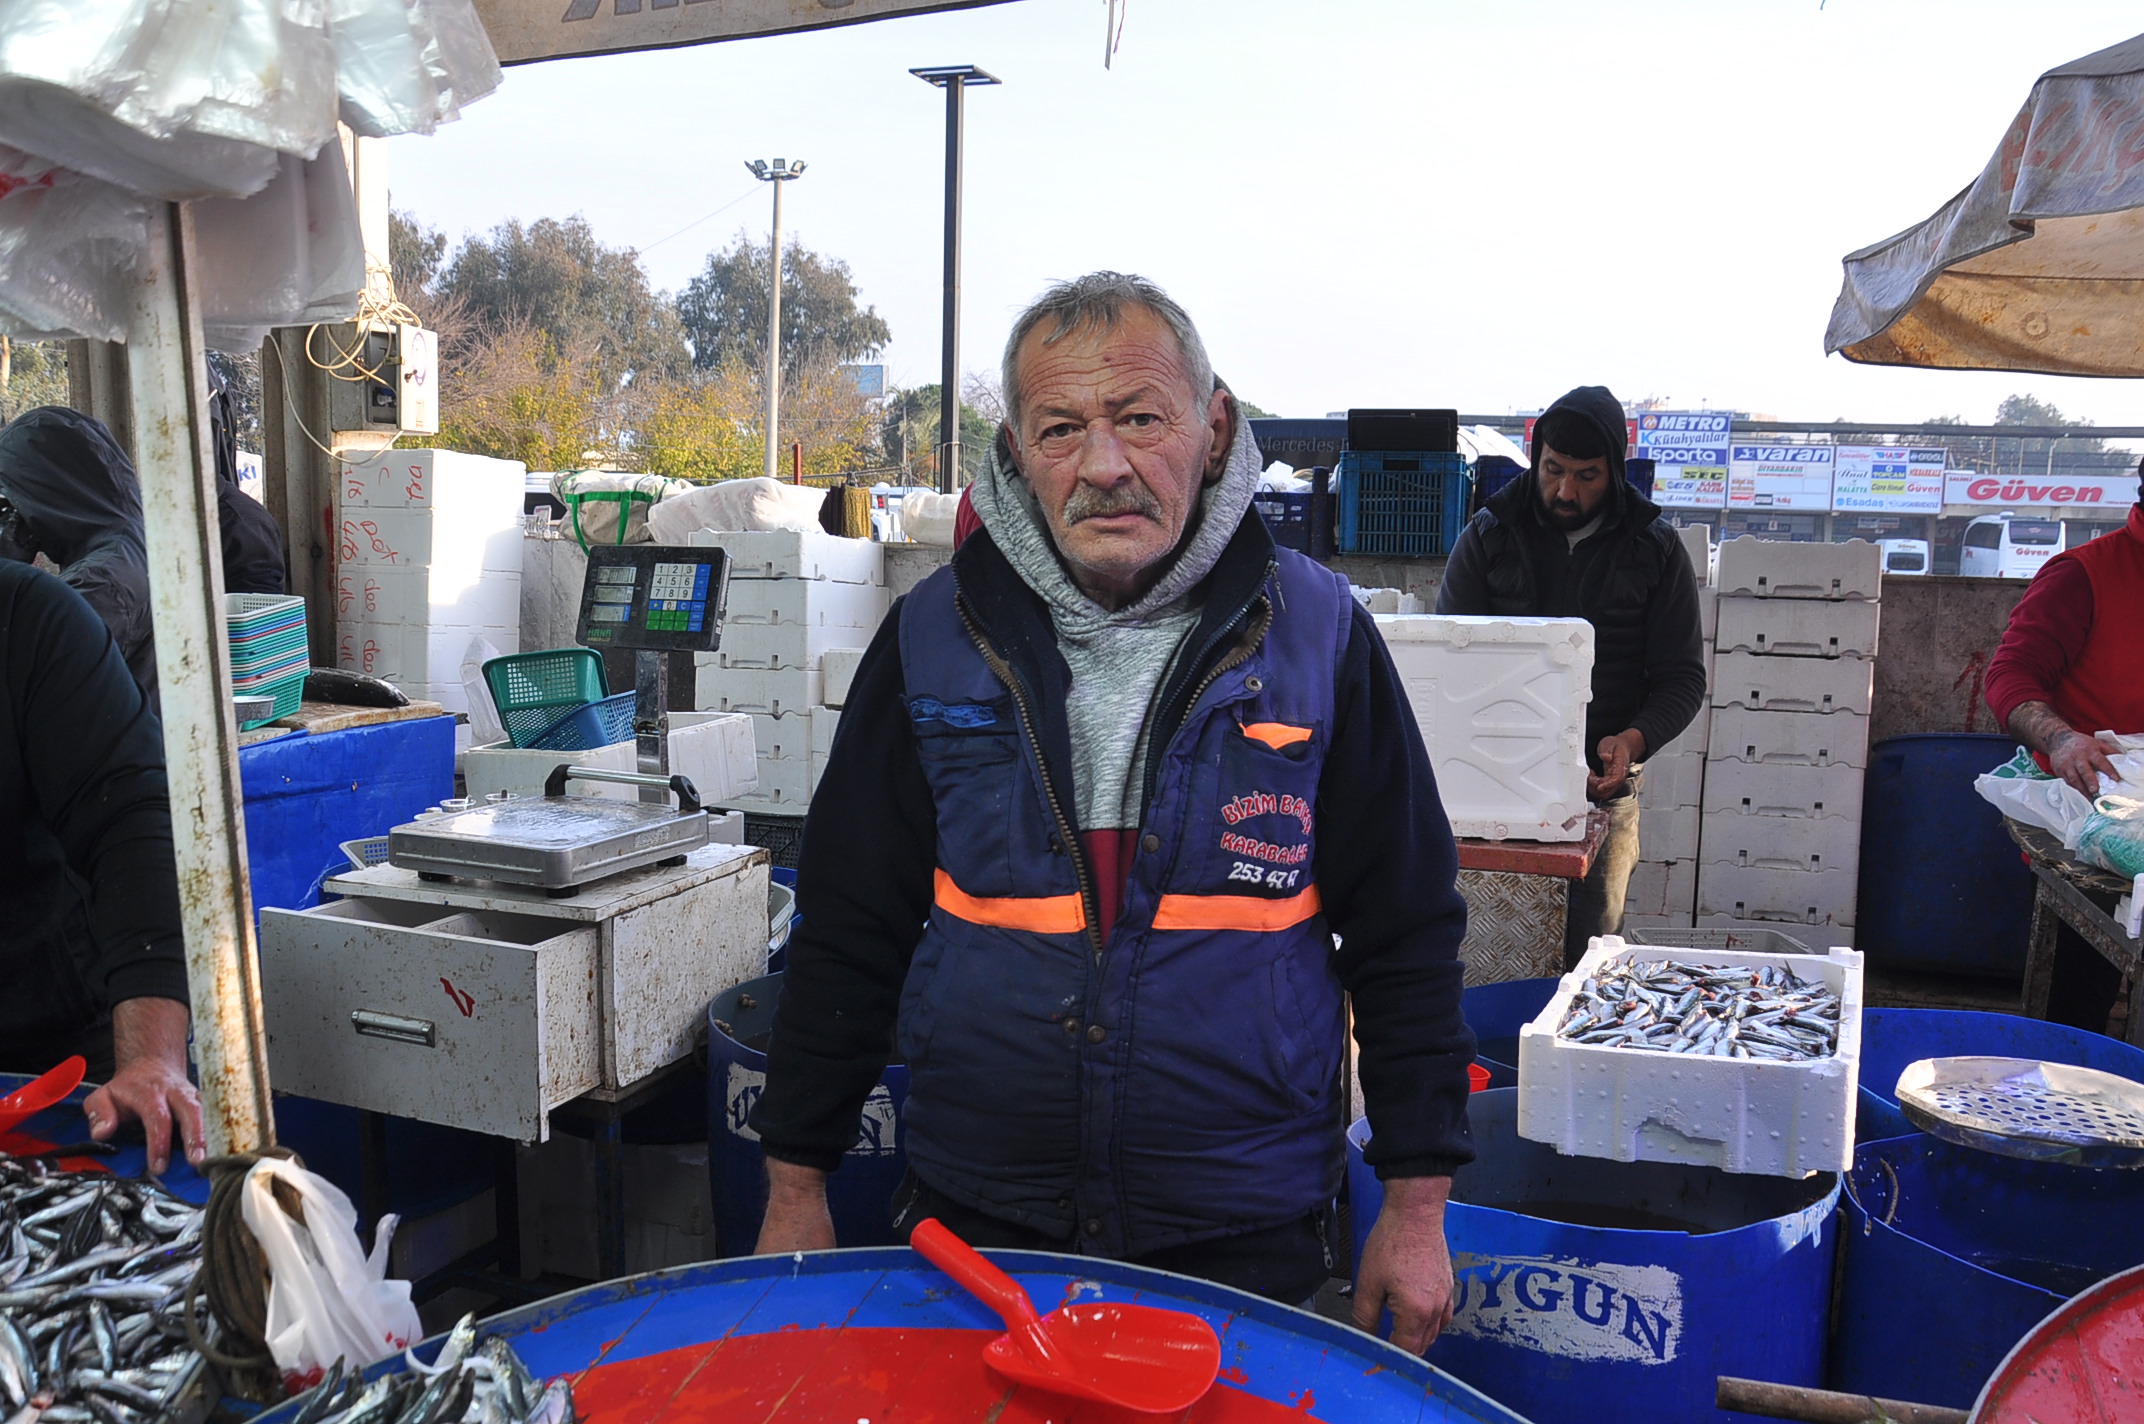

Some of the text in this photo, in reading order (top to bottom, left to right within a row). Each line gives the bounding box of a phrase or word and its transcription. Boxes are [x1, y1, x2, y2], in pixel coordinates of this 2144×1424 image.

[1658, 415, 1727, 431] METRO
[1654, 432, 1727, 446] Kütahyalılar
[1648, 447, 1717, 463] Isparta
[1756, 447, 1831, 461] varan
[1967, 478, 2103, 503] Güven
[2016, 547, 2049, 556] Güven
[1221, 790, 1277, 825] BİZİM
[1228, 861, 1265, 884] 253
